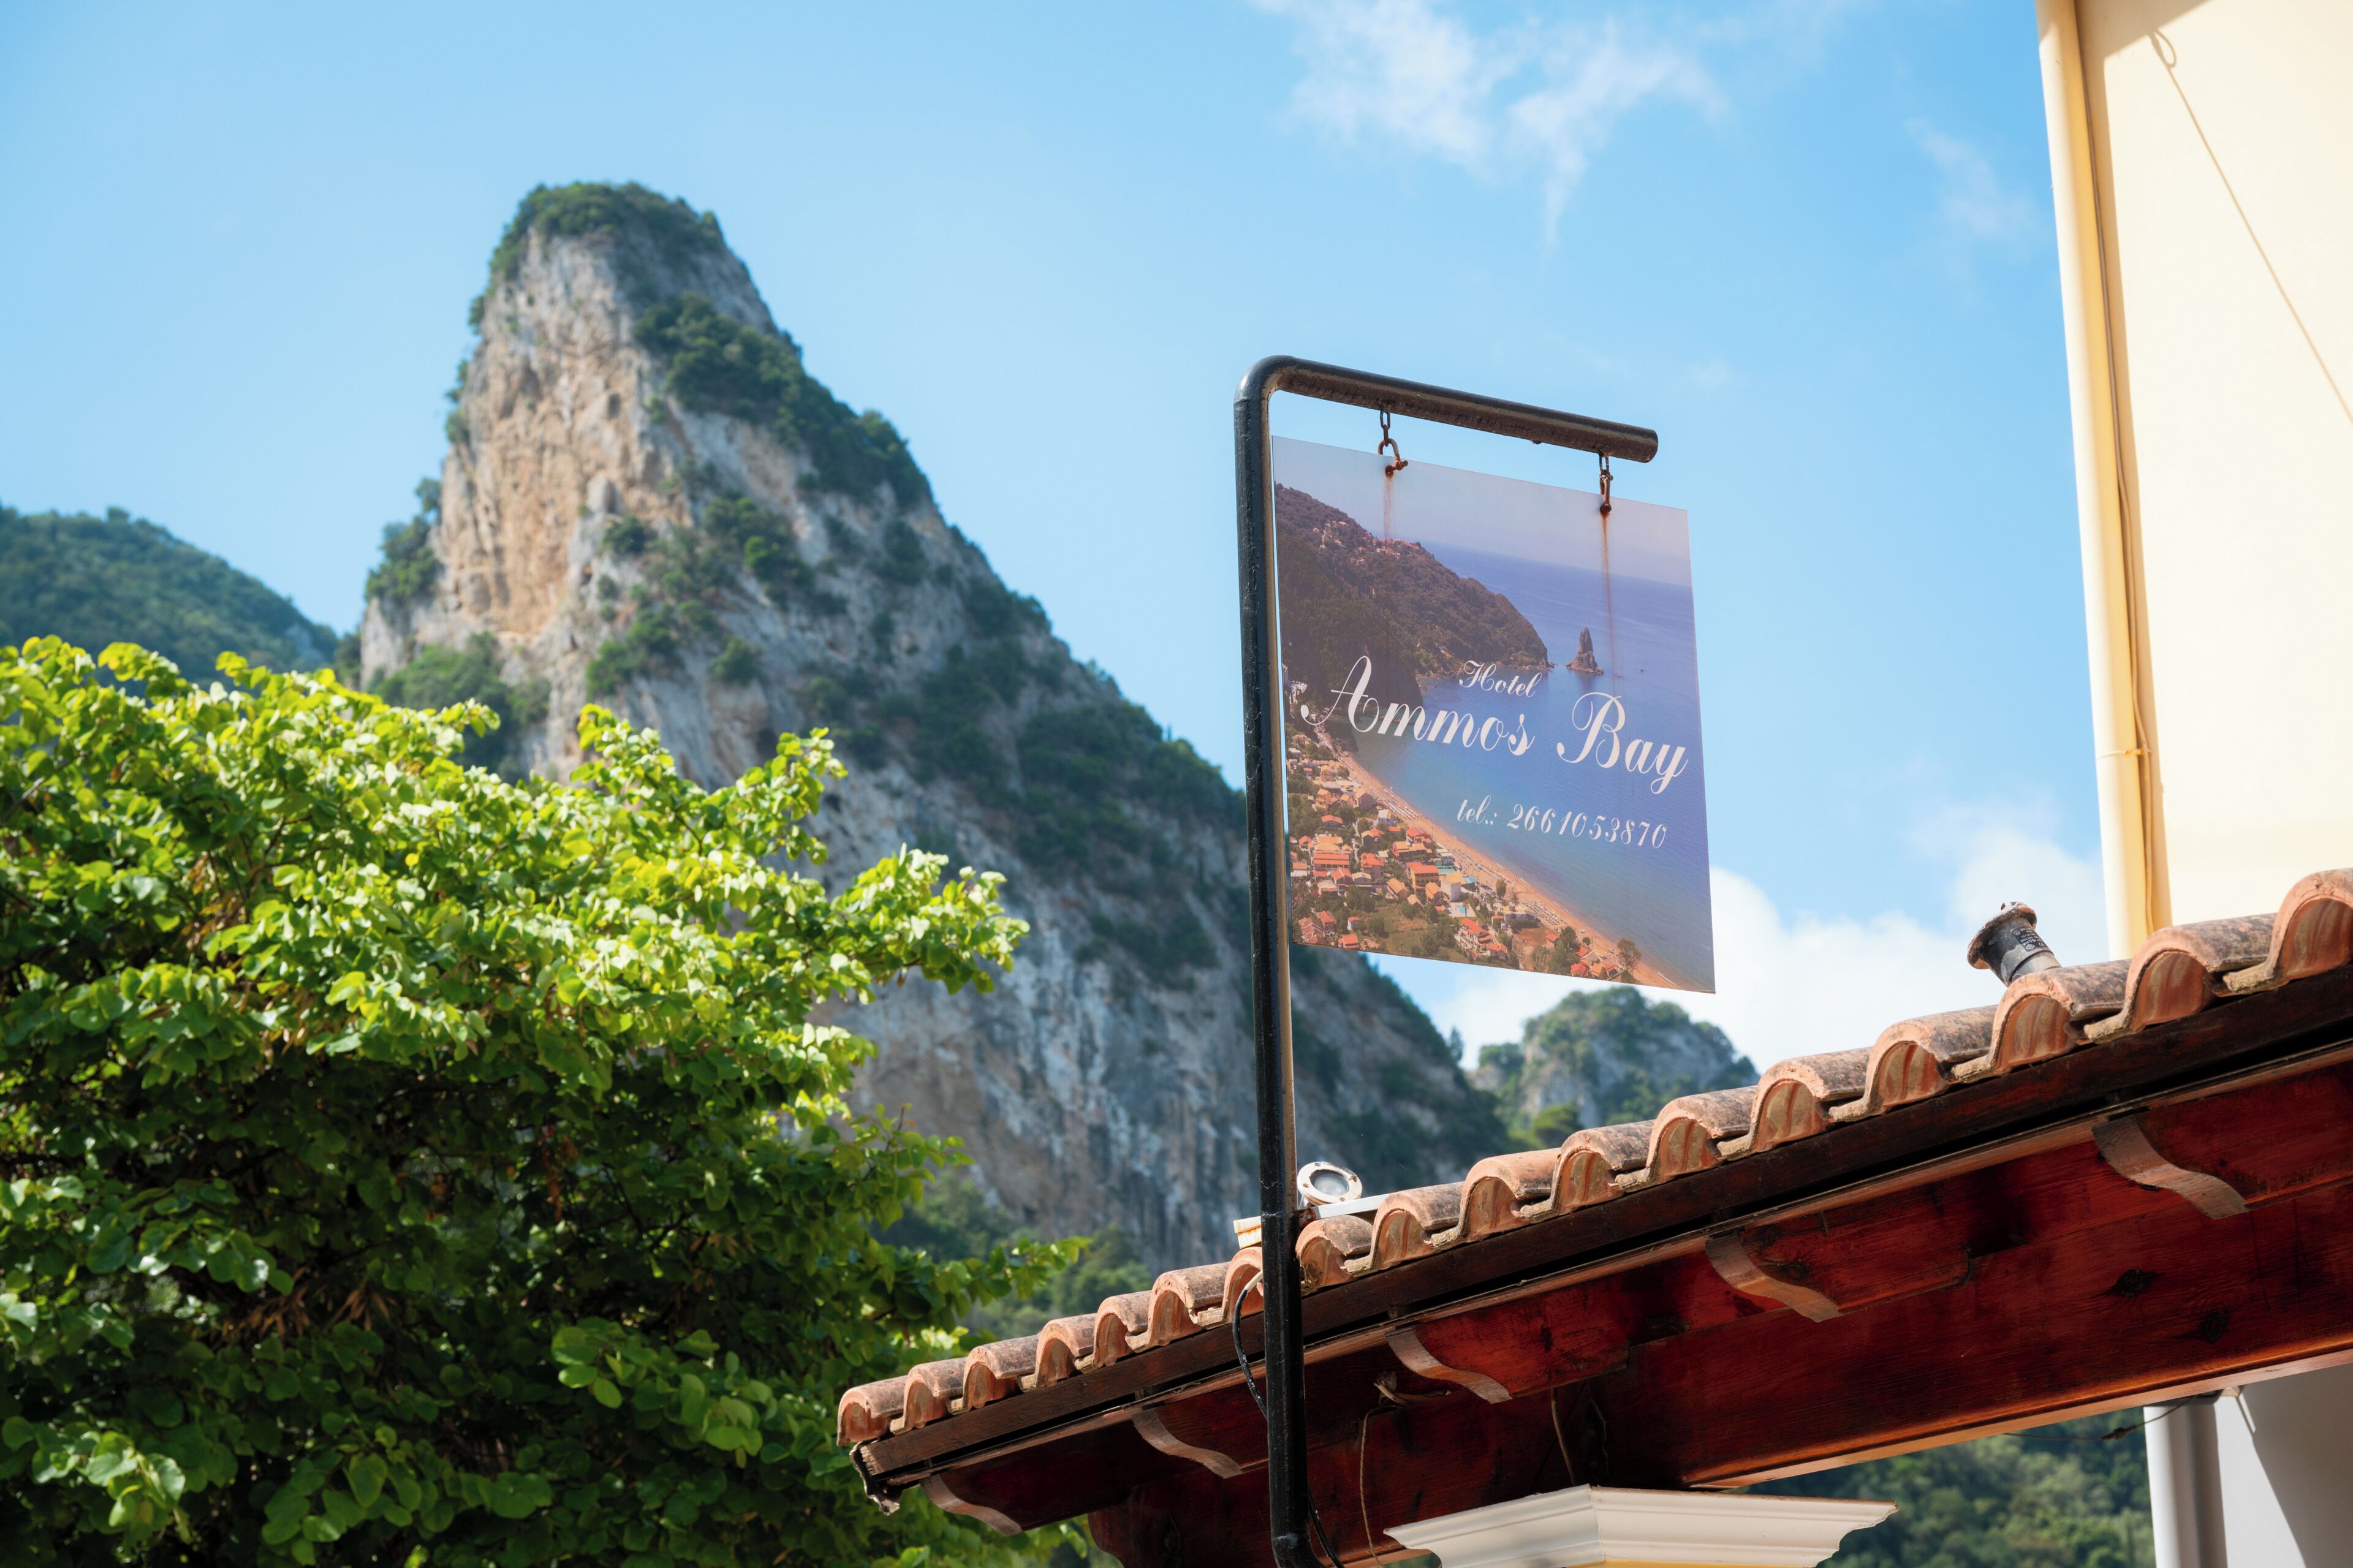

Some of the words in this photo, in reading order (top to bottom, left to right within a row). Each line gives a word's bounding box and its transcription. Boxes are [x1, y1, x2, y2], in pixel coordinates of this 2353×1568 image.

[1459, 660, 1542, 698] Hotel
[1300, 655, 1535, 756] Ammos
[1556, 692, 1688, 795] Bay
[1457, 795, 1498, 825] tel.:
[1506, 803, 1667, 849] 2661053870
